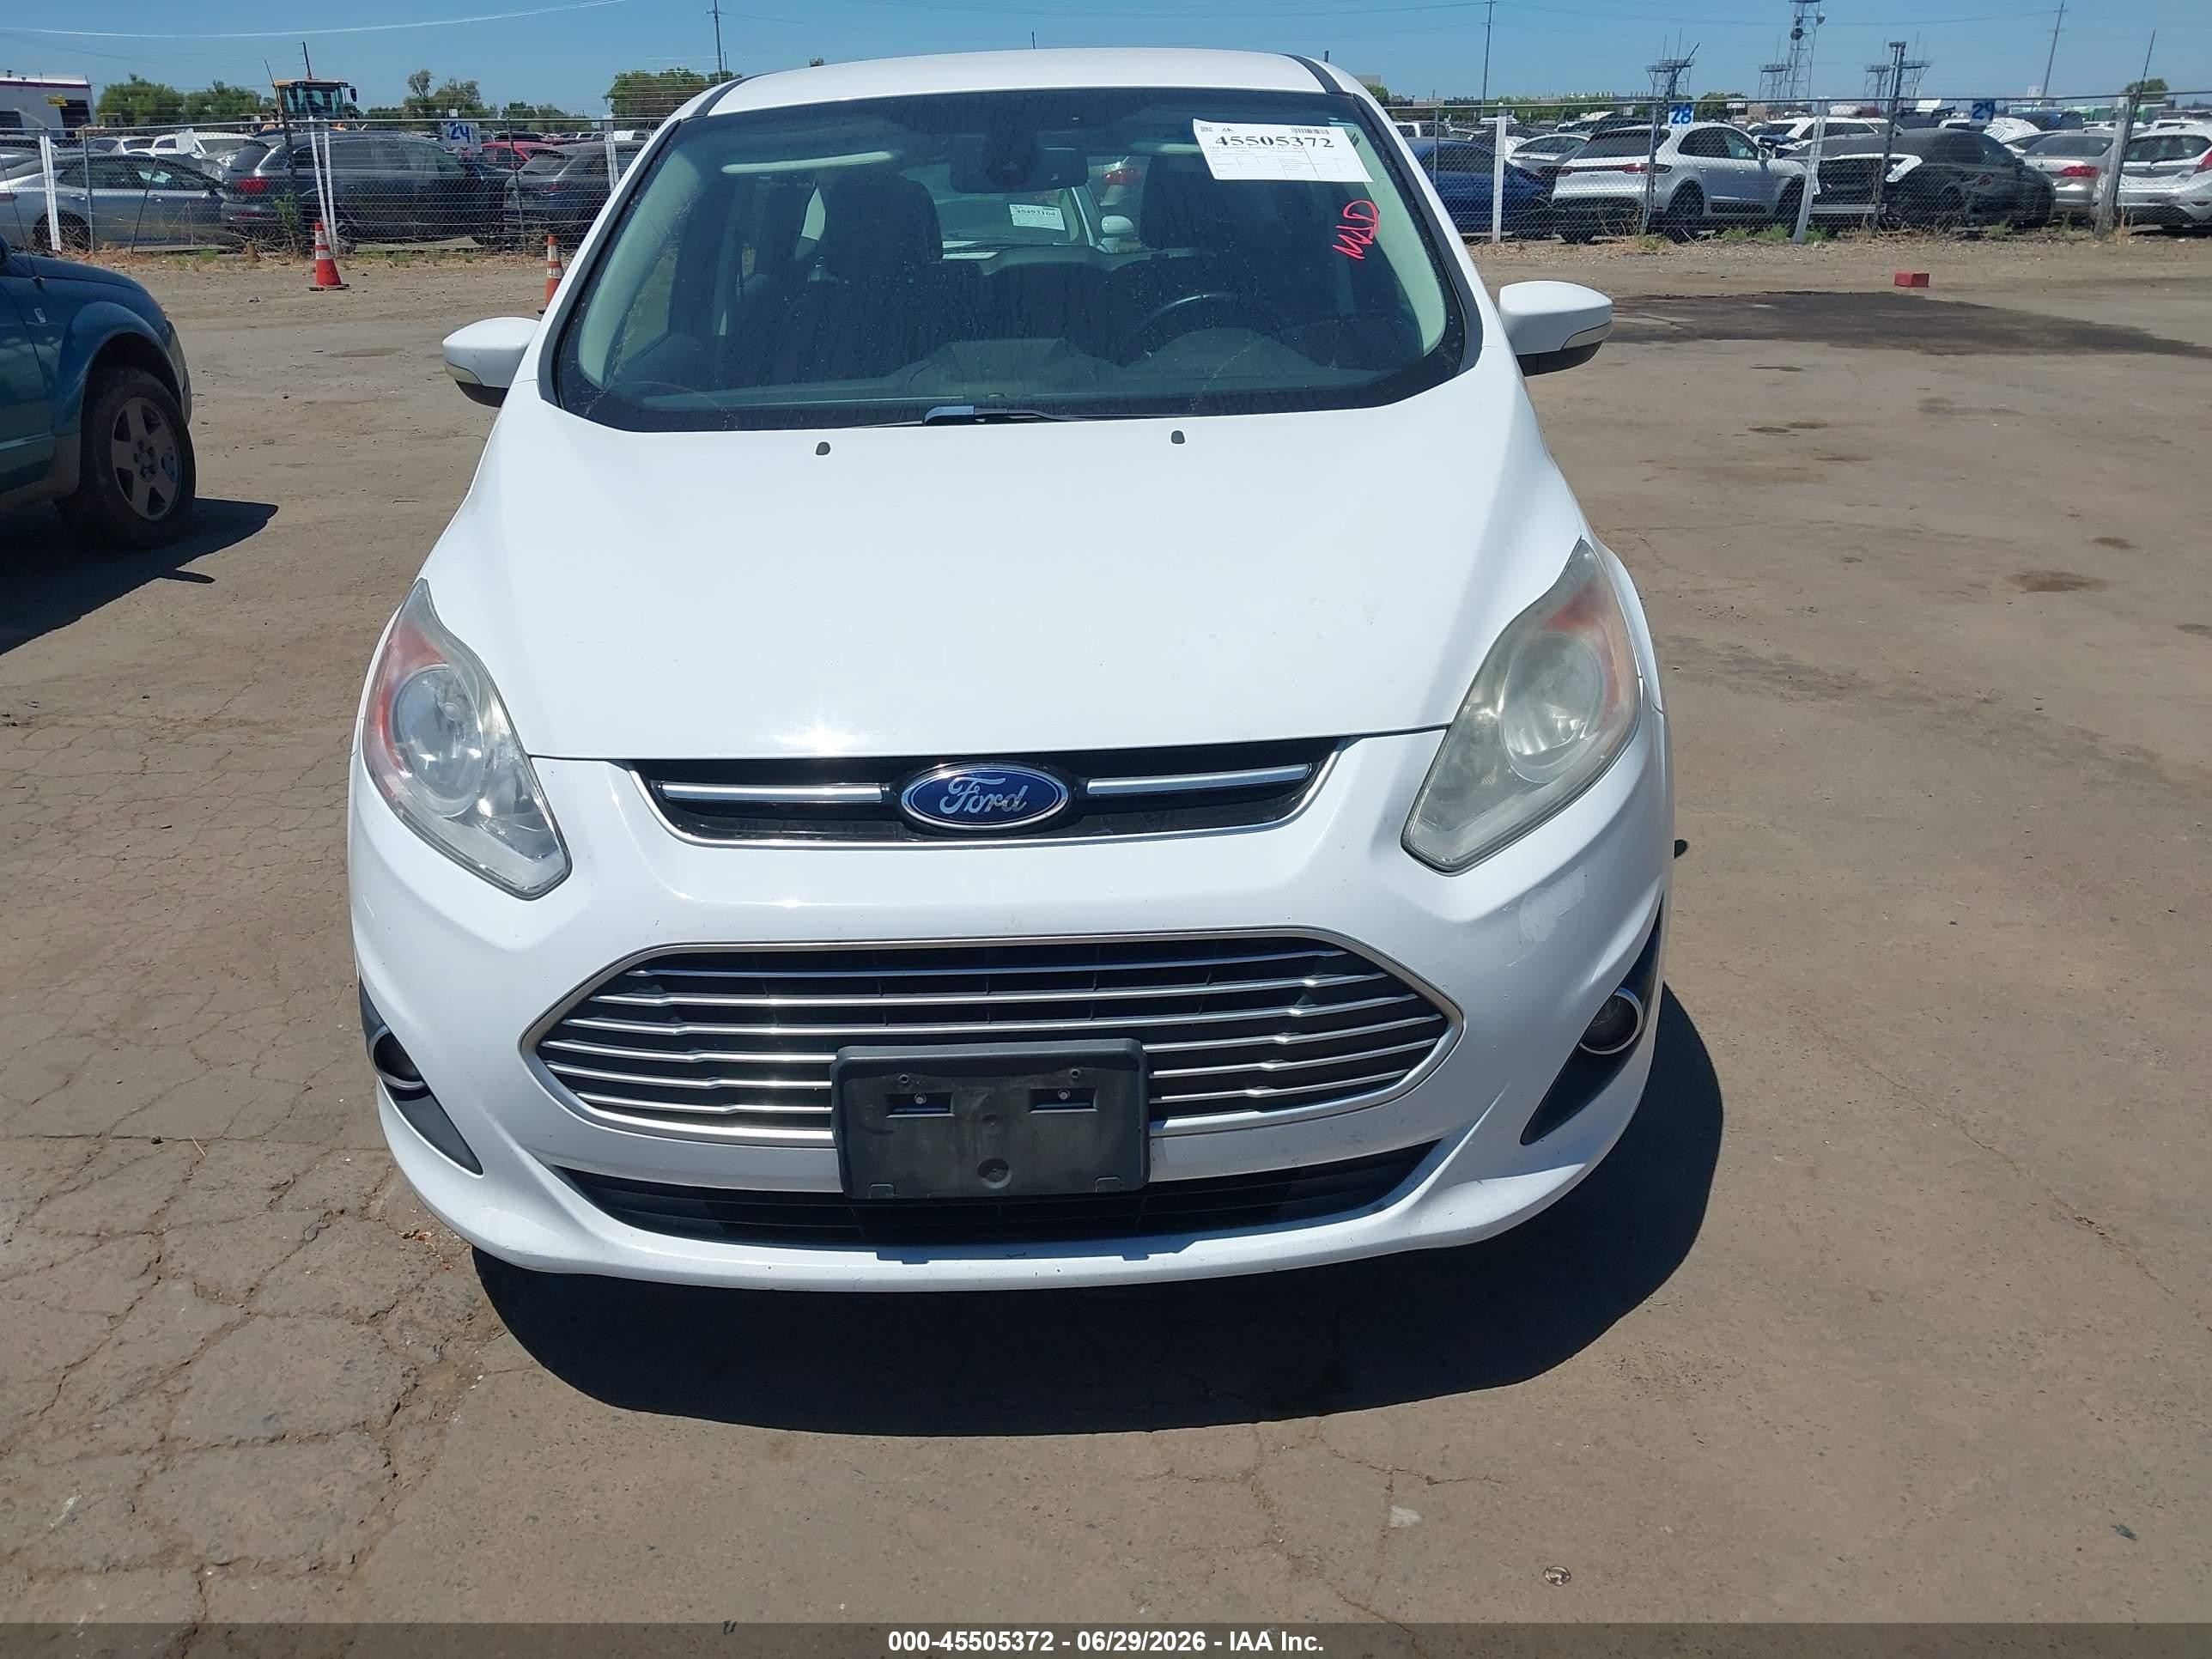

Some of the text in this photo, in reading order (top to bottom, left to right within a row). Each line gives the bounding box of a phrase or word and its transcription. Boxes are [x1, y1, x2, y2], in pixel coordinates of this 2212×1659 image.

[1670, 104, 1692, 124] 28
[1972, 102, 1995, 120] 29
[449, 123, 471, 143] 24
[1215, 136, 1334, 148] 45505372
[939, 776, 1029, 815] Ford
